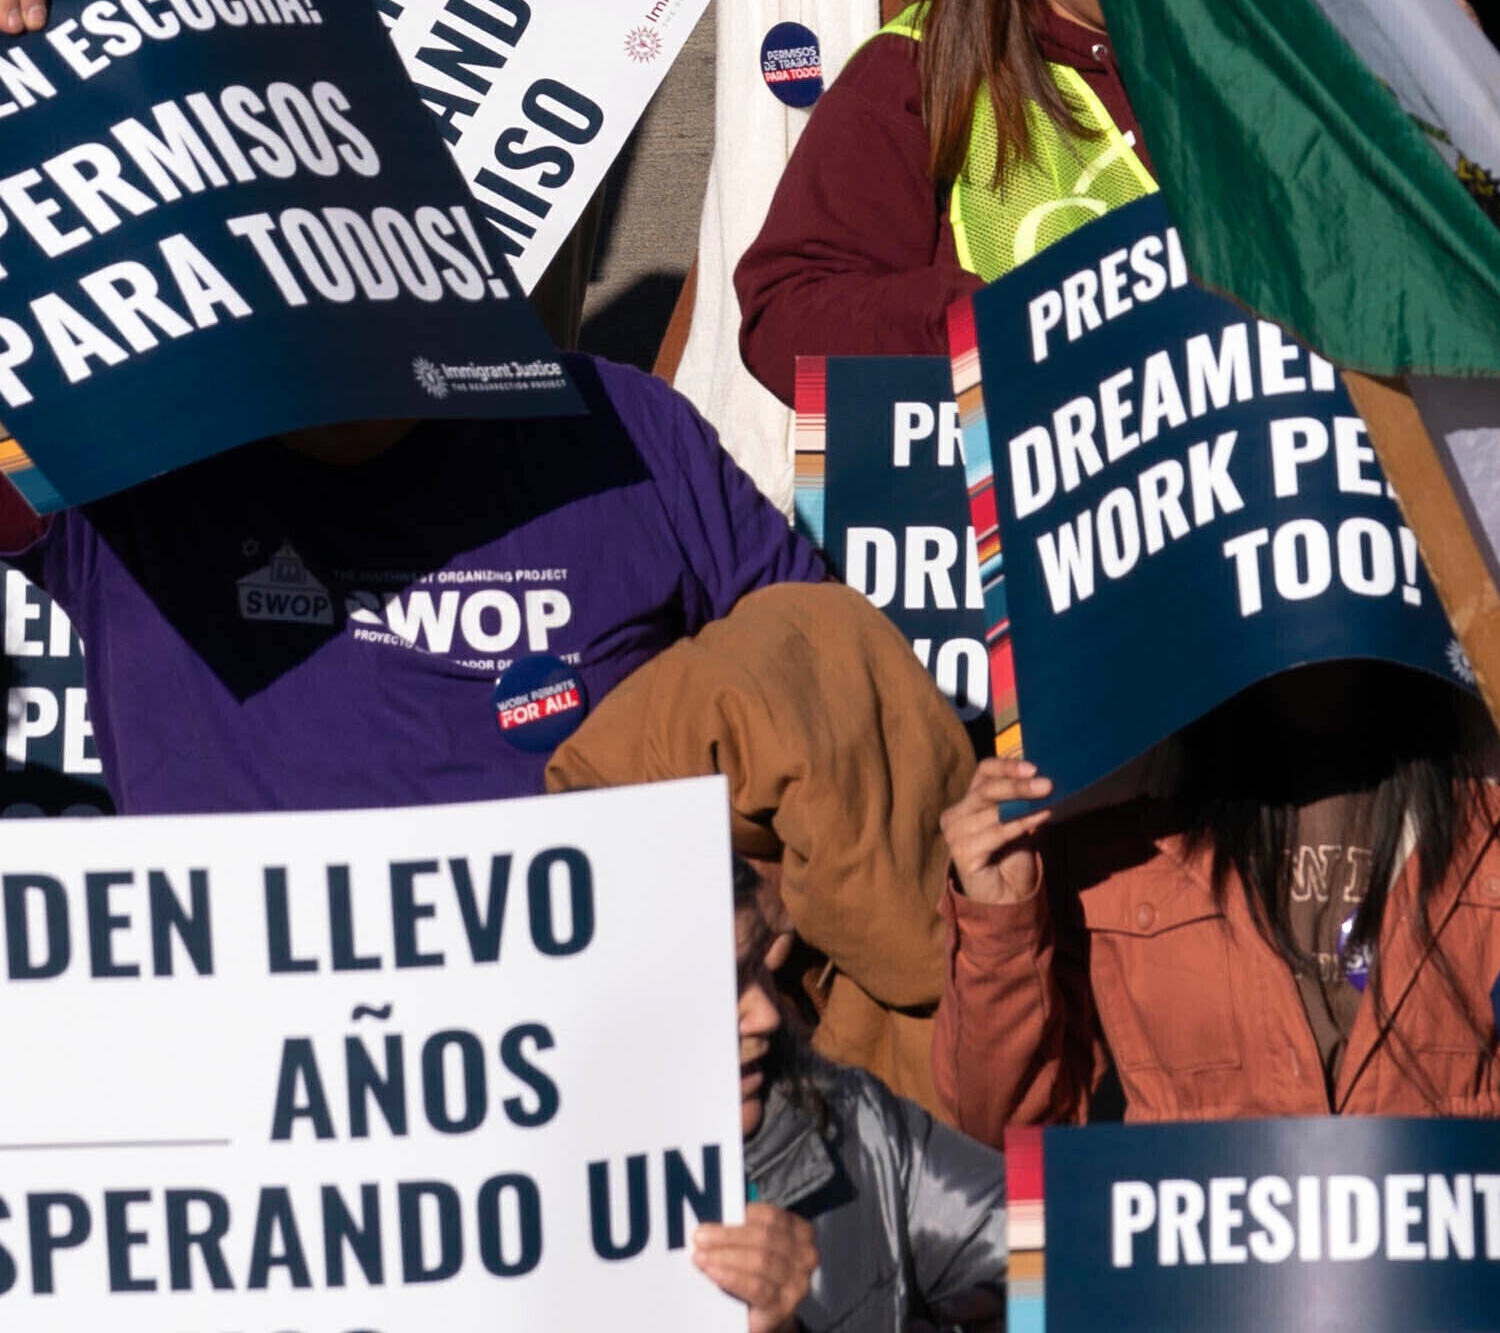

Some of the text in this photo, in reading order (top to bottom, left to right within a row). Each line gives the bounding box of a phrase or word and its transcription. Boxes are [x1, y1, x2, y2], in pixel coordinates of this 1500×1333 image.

[765, 71, 790, 83] PARA
[766, 46, 817, 62] PERMISOS
[228, 205, 509, 311] TODOS!
[441, 359, 562, 382] Immigrant Justice
[1035, 432, 1240, 617] WORK
[246, 591, 328, 616] SWOP
[515, 567, 568, 582] PROJECT
[1222, 519, 1421, 622] TOO!
[499, 689, 581, 729] FOR ALL
[261, 846, 596, 977] LLEVO
[269, 1004, 561, 1144] AÑOS
[587, 1143, 724, 1262] UN
